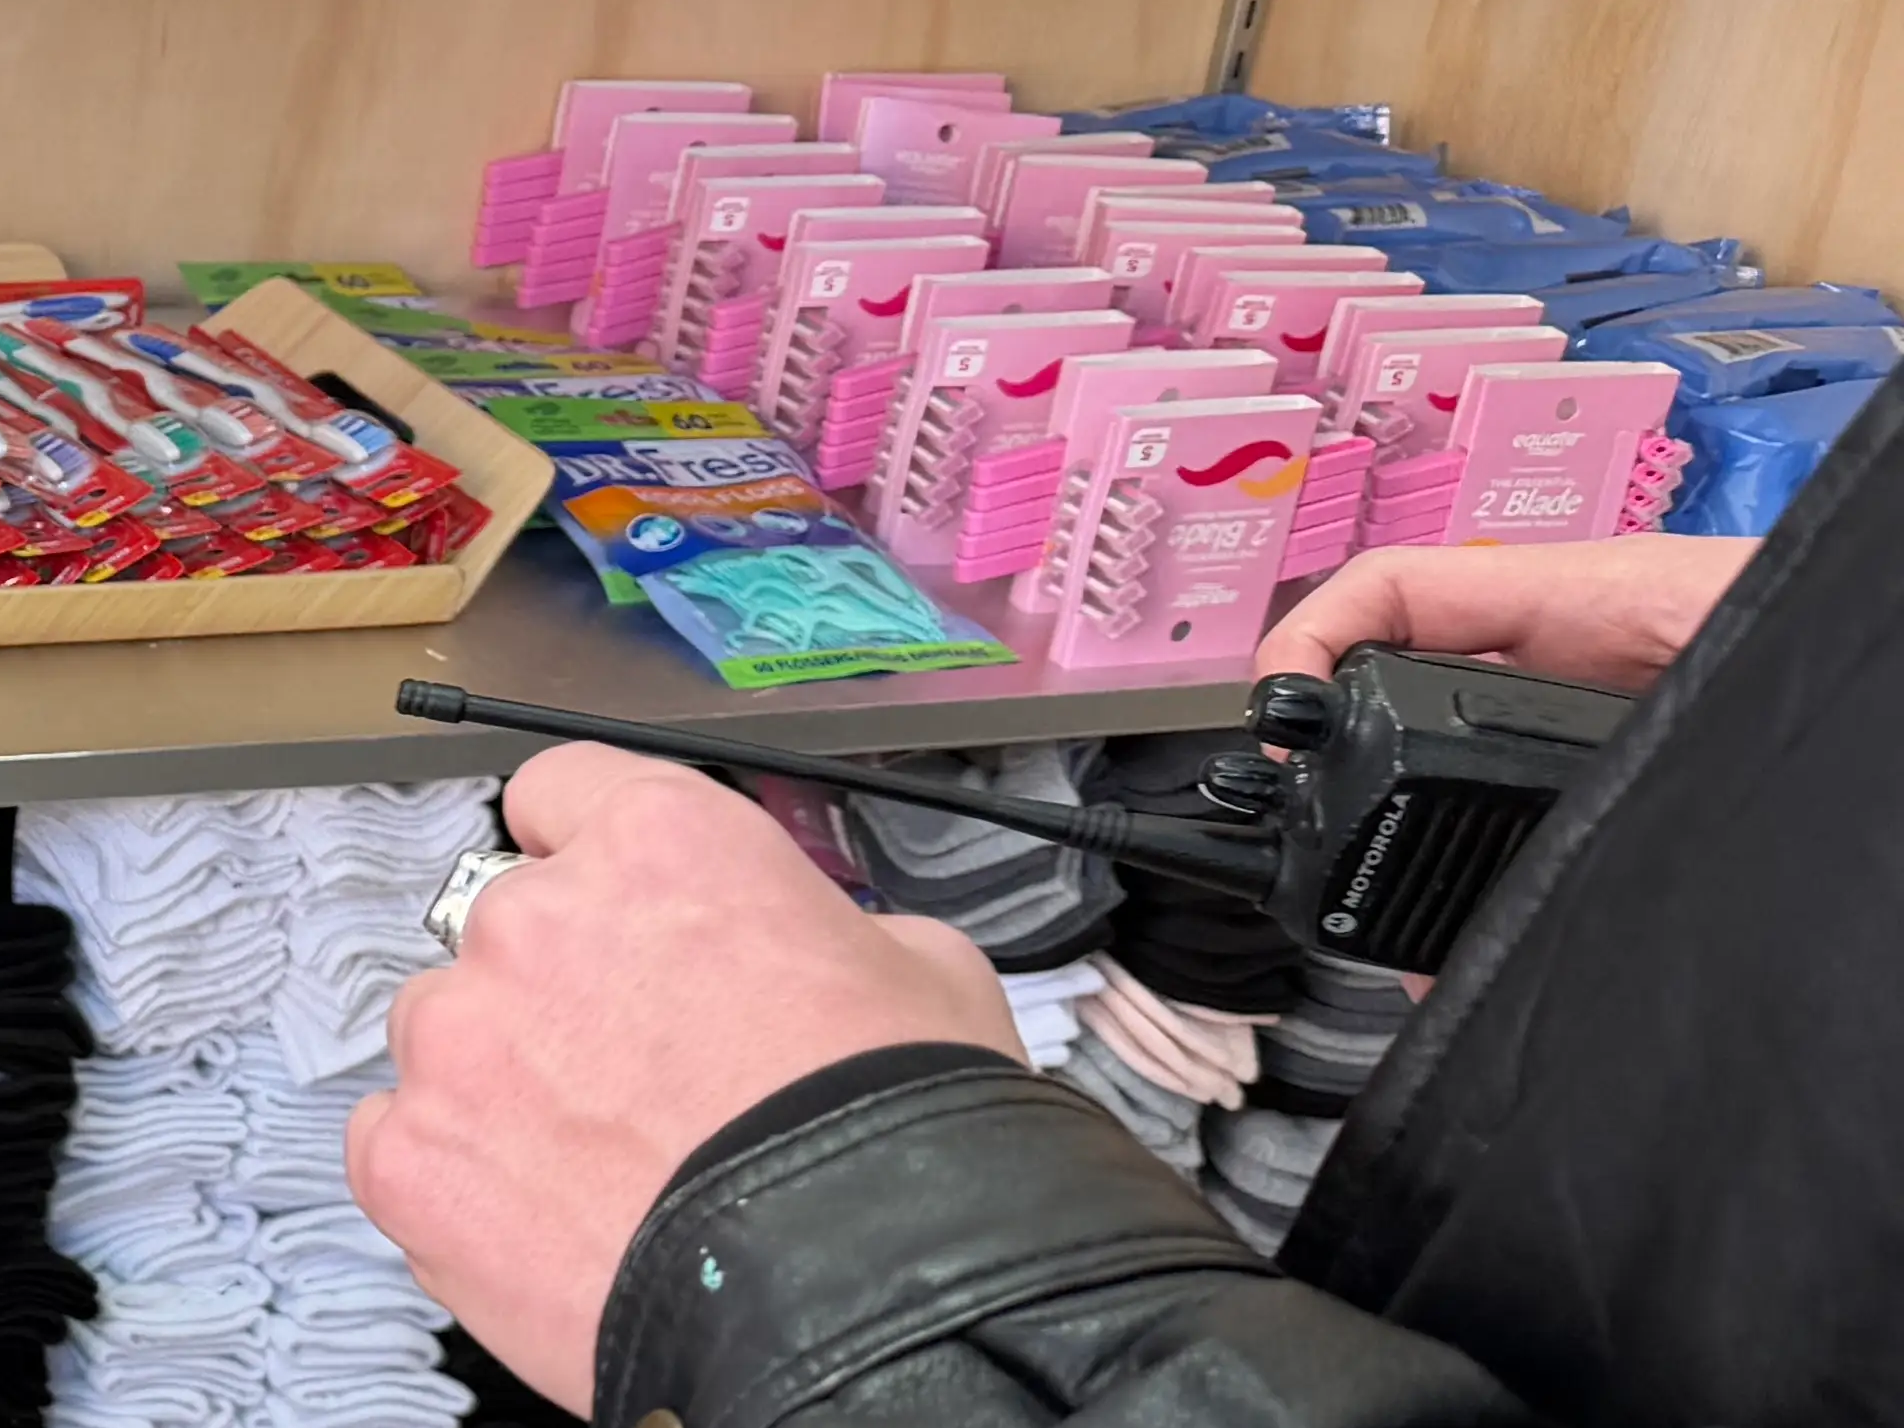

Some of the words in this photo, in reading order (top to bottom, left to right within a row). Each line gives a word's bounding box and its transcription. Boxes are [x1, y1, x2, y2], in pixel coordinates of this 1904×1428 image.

[552, 453, 658, 486] DR.
[633, 441, 800, 486] Fresh
[1471, 489, 1497, 517] 2
[1501, 487, 1584, 517] Blade
[1342, 794, 1412, 908] MOTOROLA
